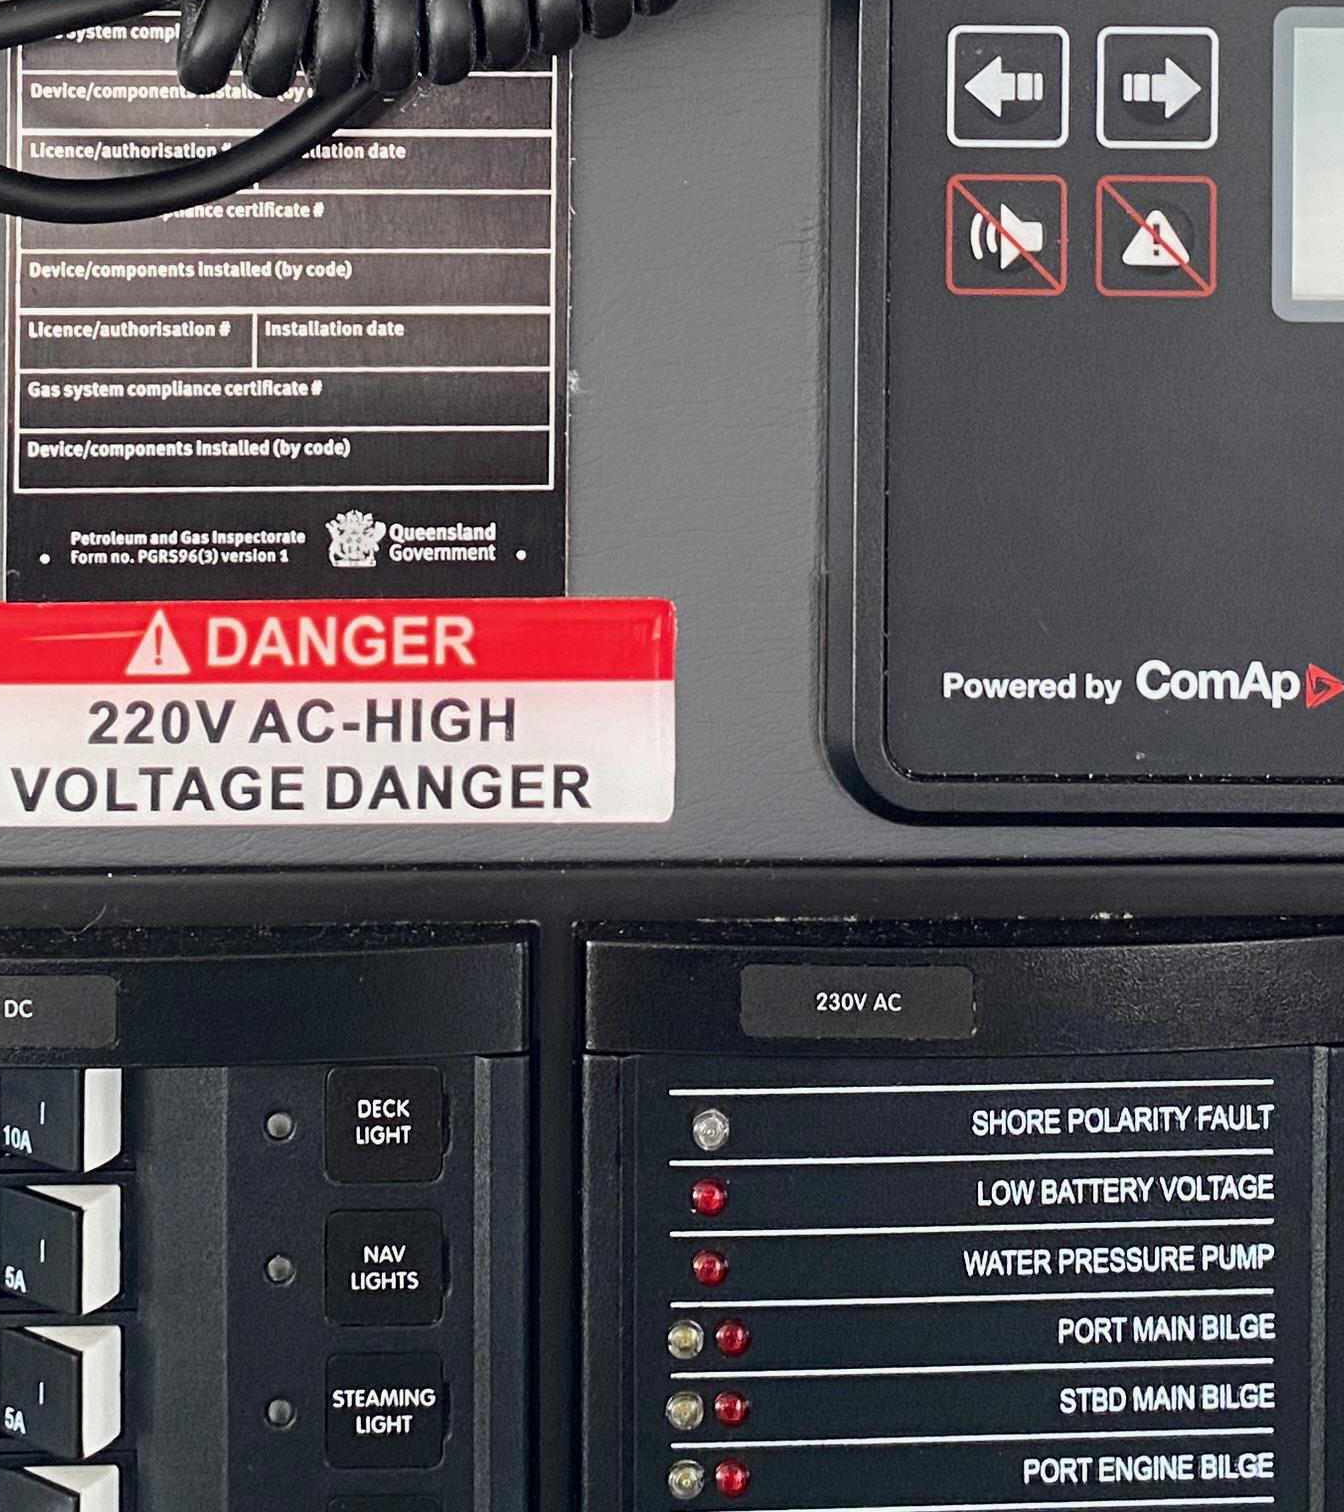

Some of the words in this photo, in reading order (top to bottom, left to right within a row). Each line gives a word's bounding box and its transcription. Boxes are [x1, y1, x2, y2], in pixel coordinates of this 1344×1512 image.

[28, 320, 216, 340] Licence/authorisation
[265, 319, 363, 337] Installation
[366, 319, 405, 337] date
[27, 439, 194, 461] Device/components
[272, 438, 302, 460] (by
[303, 437, 351, 458] code)
[70, 530, 148, 546] Petroleum
[149, 529, 178, 546] and
[180, 529, 210, 545] Gas
[211, 529, 306, 548] Inspectorate
[388, 521, 497, 544] Queensland
[70, 549, 108, 565] Form
[110, 552, 135, 564] no.
[220, 547, 277, 563] version
[279, 548, 289, 563] 1
[389, 543, 497, 562] Government
[207, 615, 476, 667] DANGER
[943, 671, 1077, 700] Powered
[1085, 672, 1123, 705] by
[1136, 659, 1301, 709] ComAp
[87, 699, 236, 745] 220V
[248, 697, 515, 744] AC-HIGH
[10, 766, 305, 813] VOLTAGE
[326, 764, 592, 810] DANGER
[4, 999, 33, 1019] DC
[357, 1098, 410, 1119] DECK
[971, 1108, 1062, 1137] SHORE
[1067, 1105, 1192, 1134] POLARITY
[1197, 1103, 1275, 1131] FAULT
[3, 1124, 33, 1154] 10A
[356, 1125, 412, 1145] LIGHT
[977, 1179, 1036, 1207] LOW
[1041, 1176, 1155, 1205] BATTERY
[1159, 1173, 1275, 1202] VOLTAGE
[363, 1244, 406, 1264] NAV
[963, 1248, 1053, 1277] WATER
[1058, 1245, 1196, 1275] PRESSURE
[1202, 1243, 1275, 1272] PUMP
[4, 1265, 27, 1294] 5A
[350, 1271, 419, 1291] LIGHTS
[332, 1388, 436, 1409] STEAMING
[355, 1414, 413, 1435] LIGHT
[1023, 1456, 1094, 1485] PORT
[1098, 1454, 1195, 1483] ENGINE
[1200, 1452, 1275, 1480] BILGE
